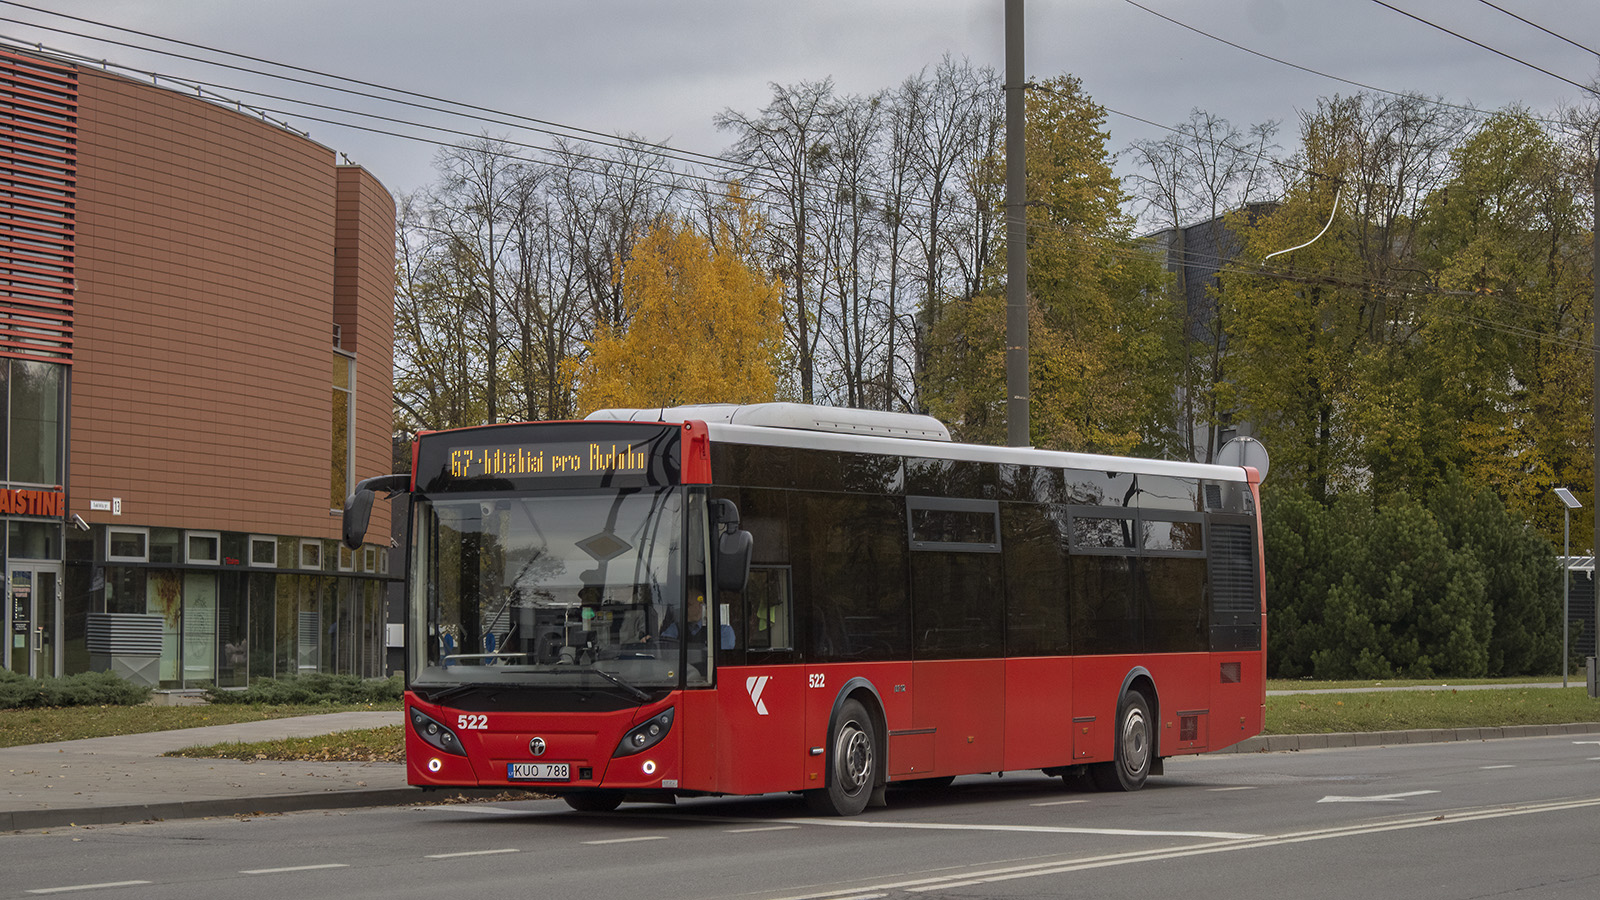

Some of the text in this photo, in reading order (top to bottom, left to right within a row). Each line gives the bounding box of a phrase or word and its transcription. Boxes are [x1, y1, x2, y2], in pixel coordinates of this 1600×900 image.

[114, 500, 120, 513] 13
[808, 673, 826, 688] 522
[457, 714, 489, 730] 522
[514, 765, 539, 777] KUO
[546, 765, 568, 777] 788
